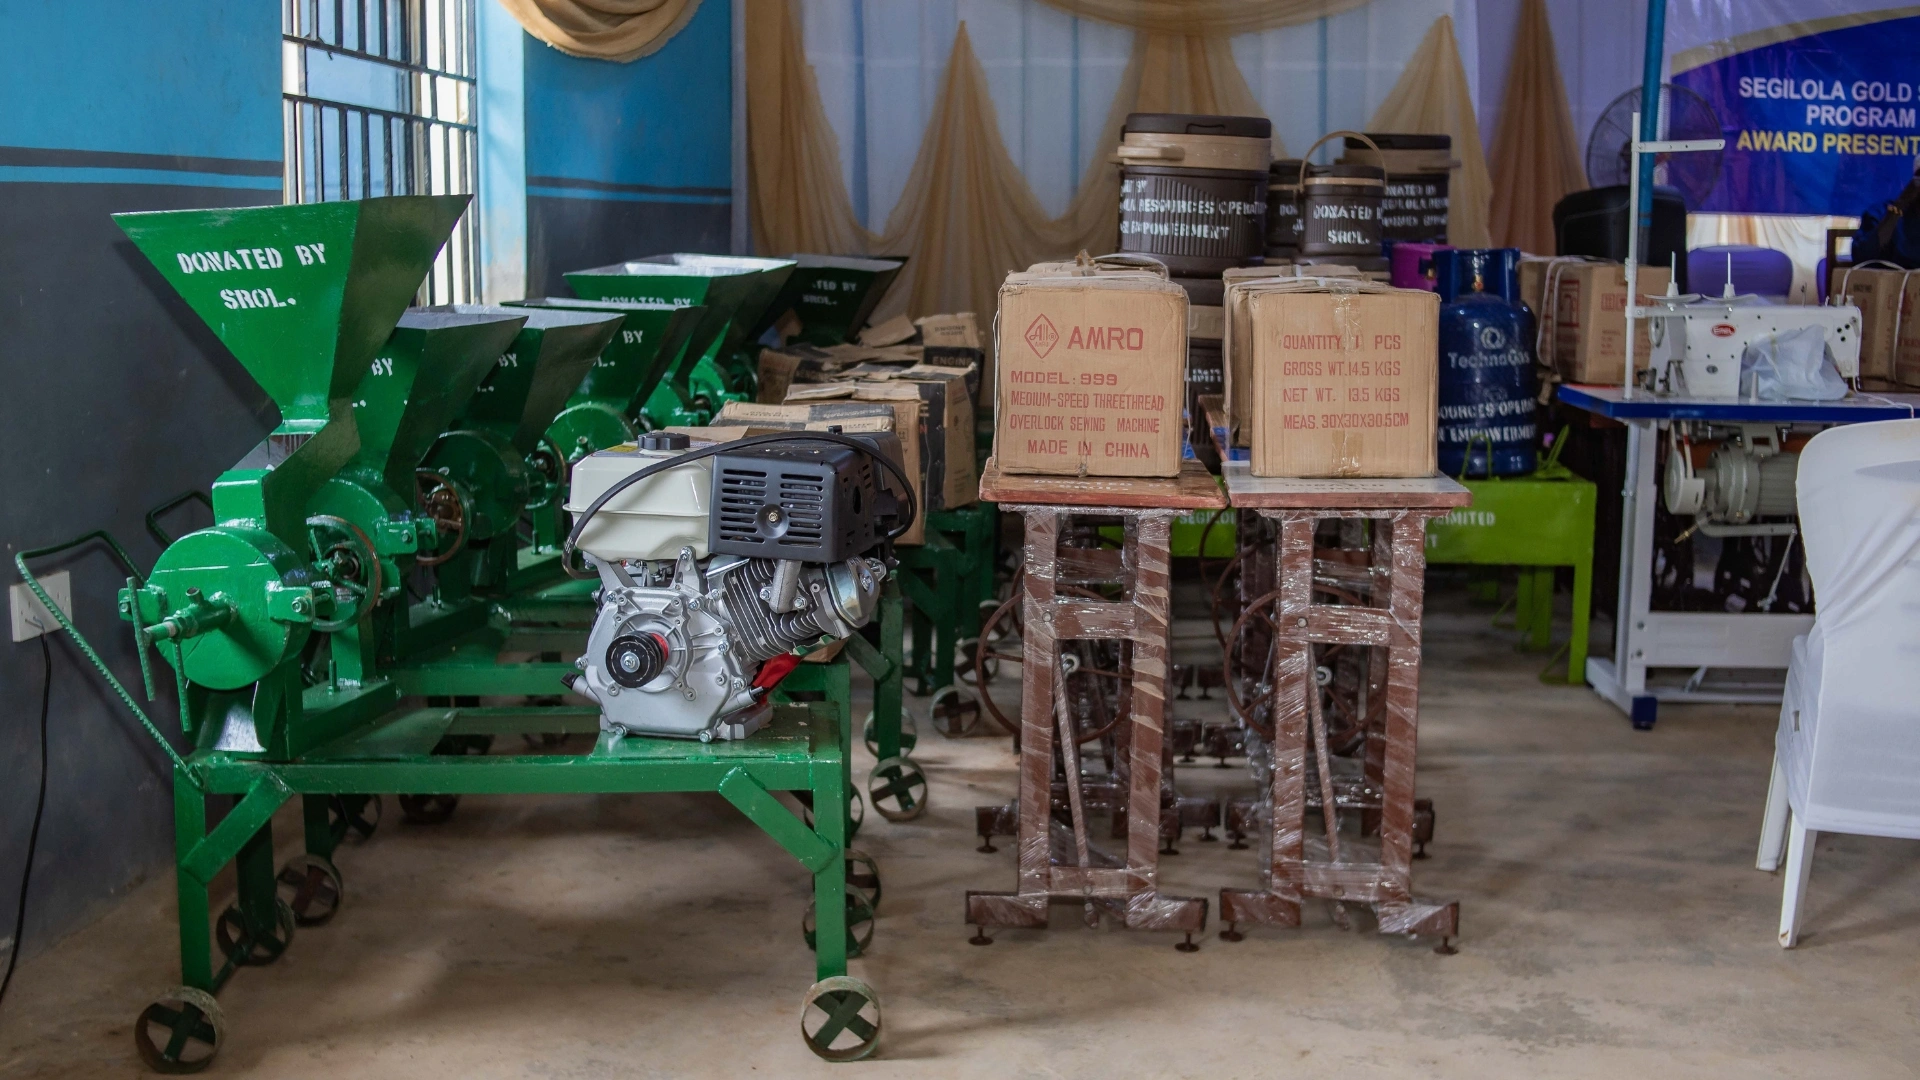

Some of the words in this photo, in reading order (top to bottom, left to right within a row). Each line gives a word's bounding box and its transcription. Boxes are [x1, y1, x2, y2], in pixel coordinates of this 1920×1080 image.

[1738, 77, 1846, 100] SEGILOLA
[1851, 81, 1912, 102] GOLD
[1806, 104, 1916, 128] PROGRAM
[1737, 130, 1817, 153] AWARD
[176, 247, 284, 275] DONATED
[294, 243, 326, 267] BY
[220, 287, 297, 310] SROL.
[622, 330, 644, 344] BY
[1066, 326, 1144, 350] AMRO
[1374, 335, 1401, 350] PCS
[371, 358, 393, 376] BY
[499, 353, 518, 367] BY
[1283, 361, 1323, 376] GROSS
[1375, 361, 1401, 376] KGS
[1080, 373, 1118, 386] 999
[1011, 391, 1089, 409] MEDIUM-SPEED
[1093, 393, 1165, 412] THREETHREAD
[1283, 387, 1308, 402] NET
[1315, 388, 1337, 402] WT.
[1348, 387, 1370, 402] 13.5
[1375, 387, 1400, 402] KGS
[1438, 404, 1495, 419] OURCES
[1010, 414, 1064, 431] OVERLOCK
[1070, 416, 1105, 432] SEWING
[1117, 418, 1160, 433] MACHINE
[1283, 415, 1319, 430] MEAS.
[1027, 439, 1068, 455] MADE
[1078, 441, 1092, 456] IN
[1105, 442, 1150, 458] CHINA
